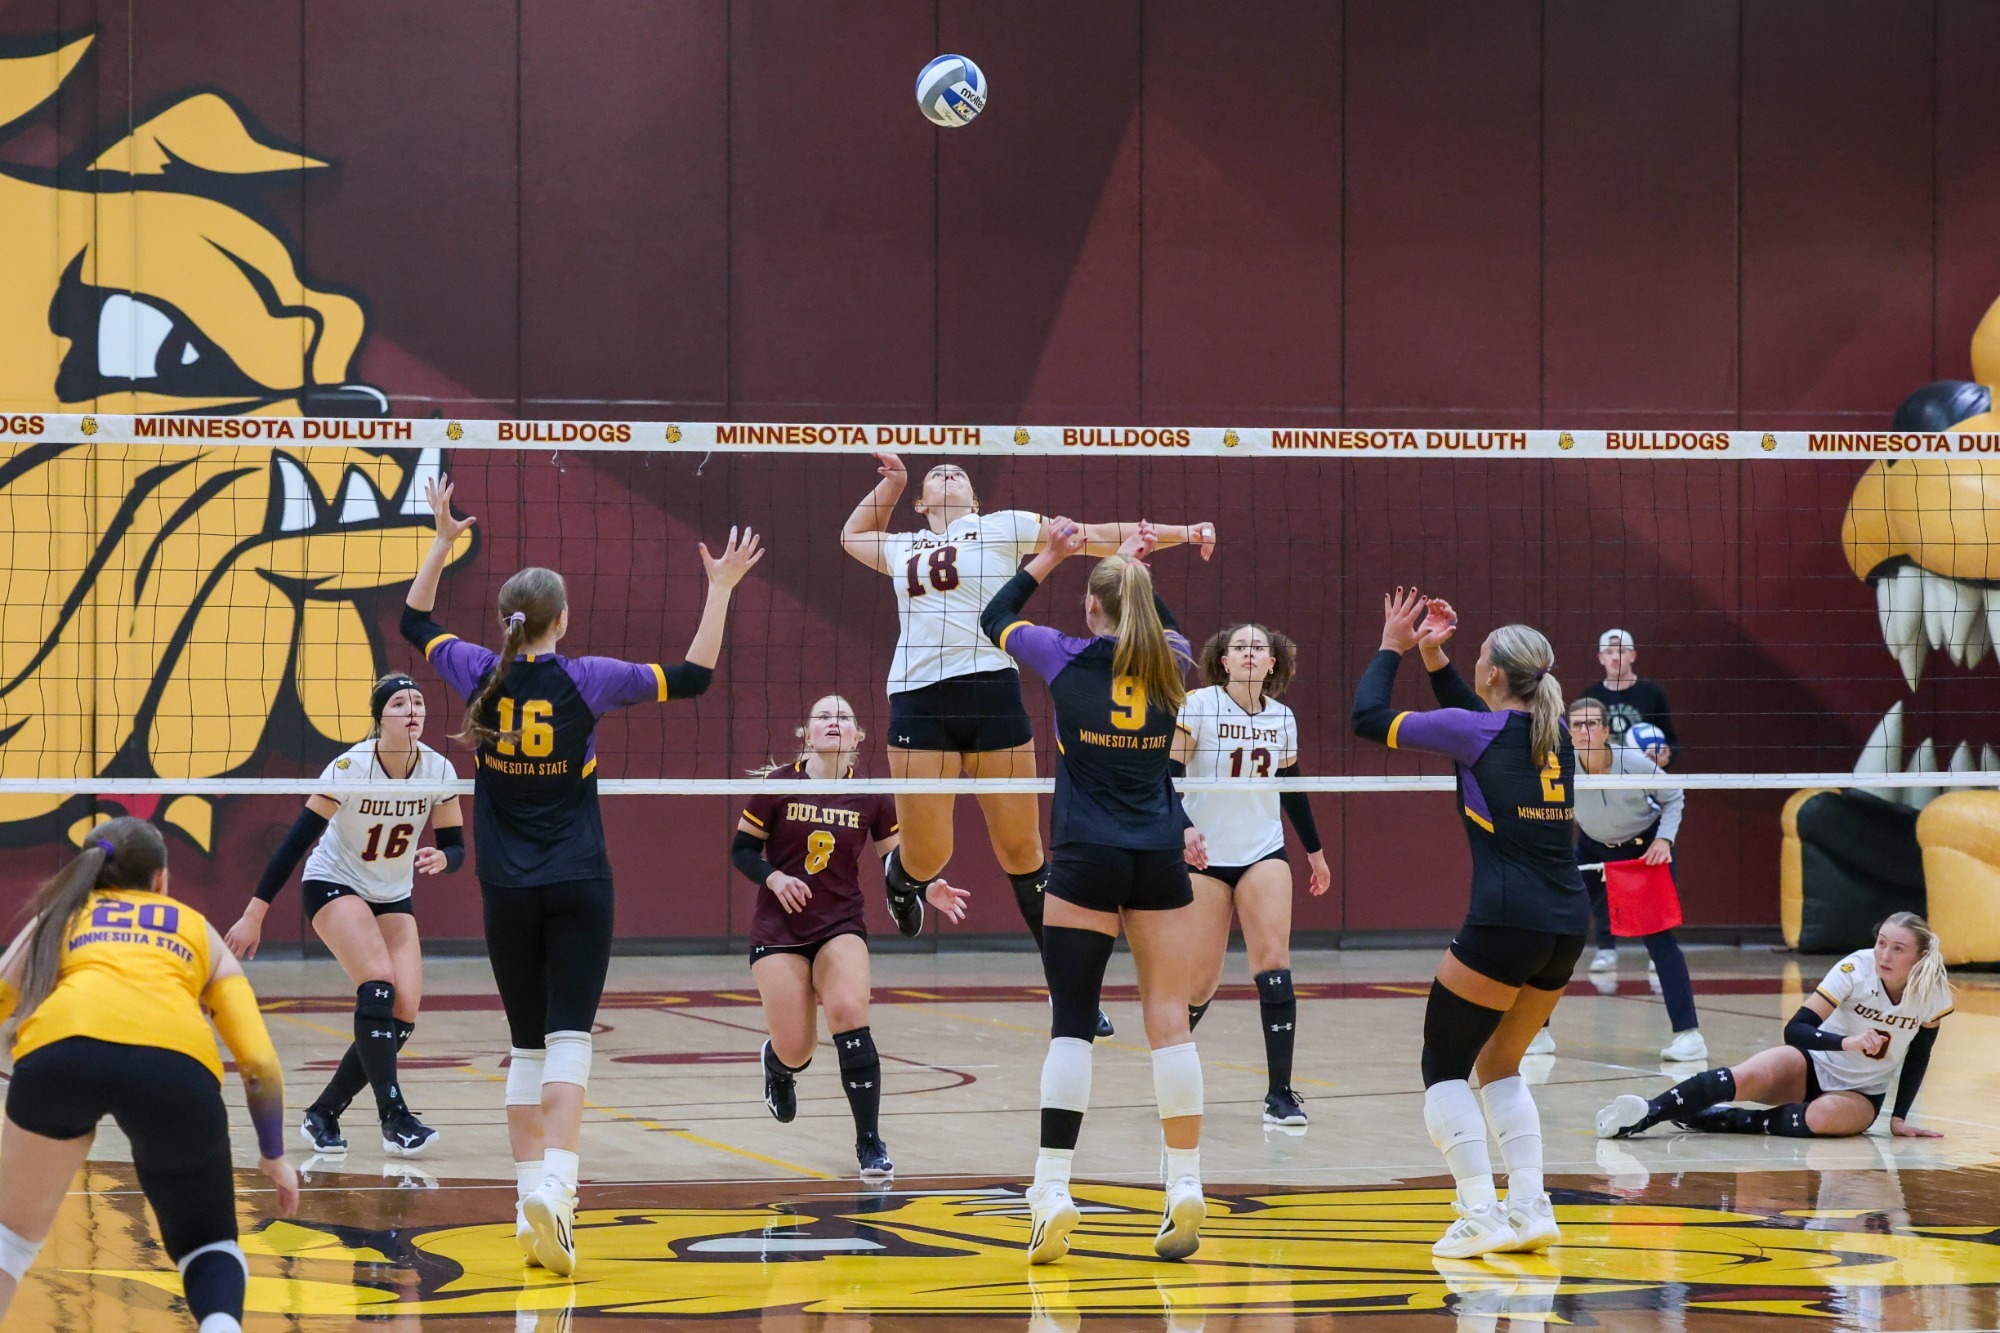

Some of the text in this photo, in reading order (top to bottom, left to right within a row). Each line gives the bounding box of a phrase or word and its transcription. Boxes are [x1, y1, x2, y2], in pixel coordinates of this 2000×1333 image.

[960, 88, 984, 109] molte
[134, 417, 412, 440] MINNESOTA DULUTH
[498, 422, 631, 442] BULLDOGS
[716, 425, 980, 446] MINNESOTA DULUTH
[1063, 428, 1190, 447] BULLDOGS
[1272, 430, 1527, 450] MINNESOTA DULUTH
[1606, 432, 1729, 450] BULLDOGS
[1808, 433, 1951, 452] MINNESOTA
[906, 546, 960, 597] 18
[1111, 675, 1147, 730] 9
[497, 697, 553, 757] 16
[1217, 723, 1277, 744] DULUTH
[1079, 729, 1167, 750] MINNESOTA STATE
[485, 753, 568, 775] MINNESOTA STATE
[1230, 747, 1271, 777] 13
[1539, 751, 1565, 802] 2
[359, 798, 427, 816] DULUTH
[786, 803, 860, 829] DULUTH
[1517, 805, 1563, 820] MINNESOTA
[361, 822, 414, 862] 16
[804, 830, 835, 875] 8
[92, 899, 179, 934] 20
[69, 931, 193, 963] MINNESOTA STATE
